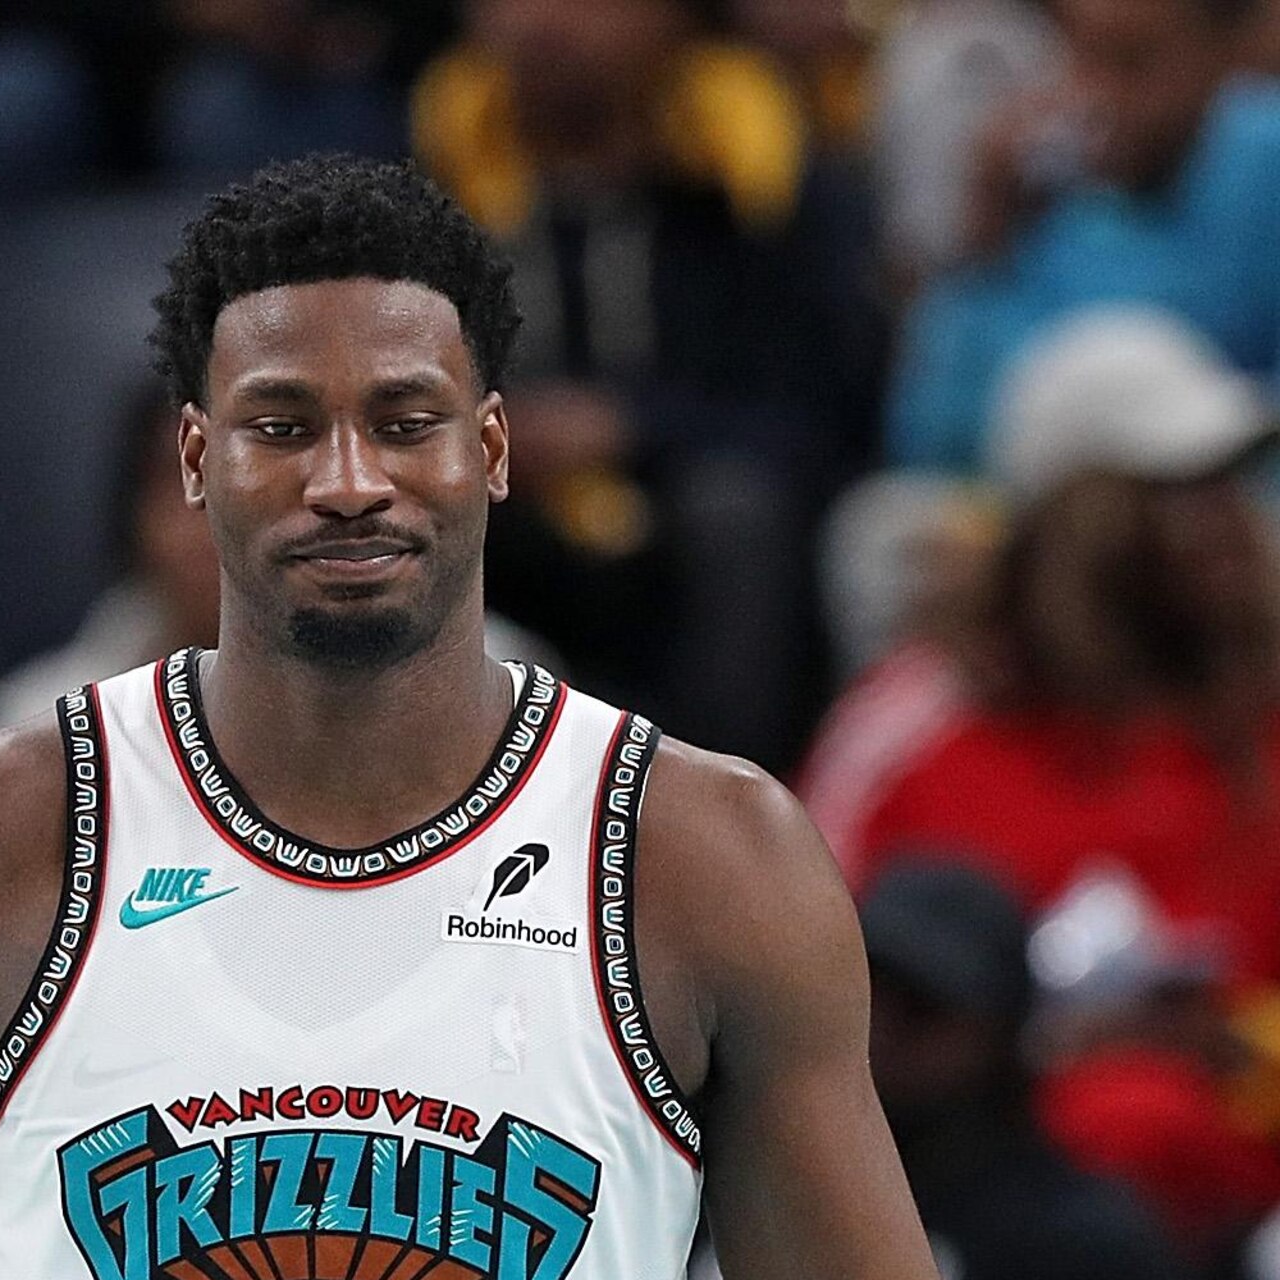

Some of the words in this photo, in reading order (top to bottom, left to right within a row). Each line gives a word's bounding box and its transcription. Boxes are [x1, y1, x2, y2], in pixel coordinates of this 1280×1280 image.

[135, 868, 211, 903] NIKE
[448, 914, 577, 948] Robinhood
[168, 1085, 480, 1143] VANCOUVER
